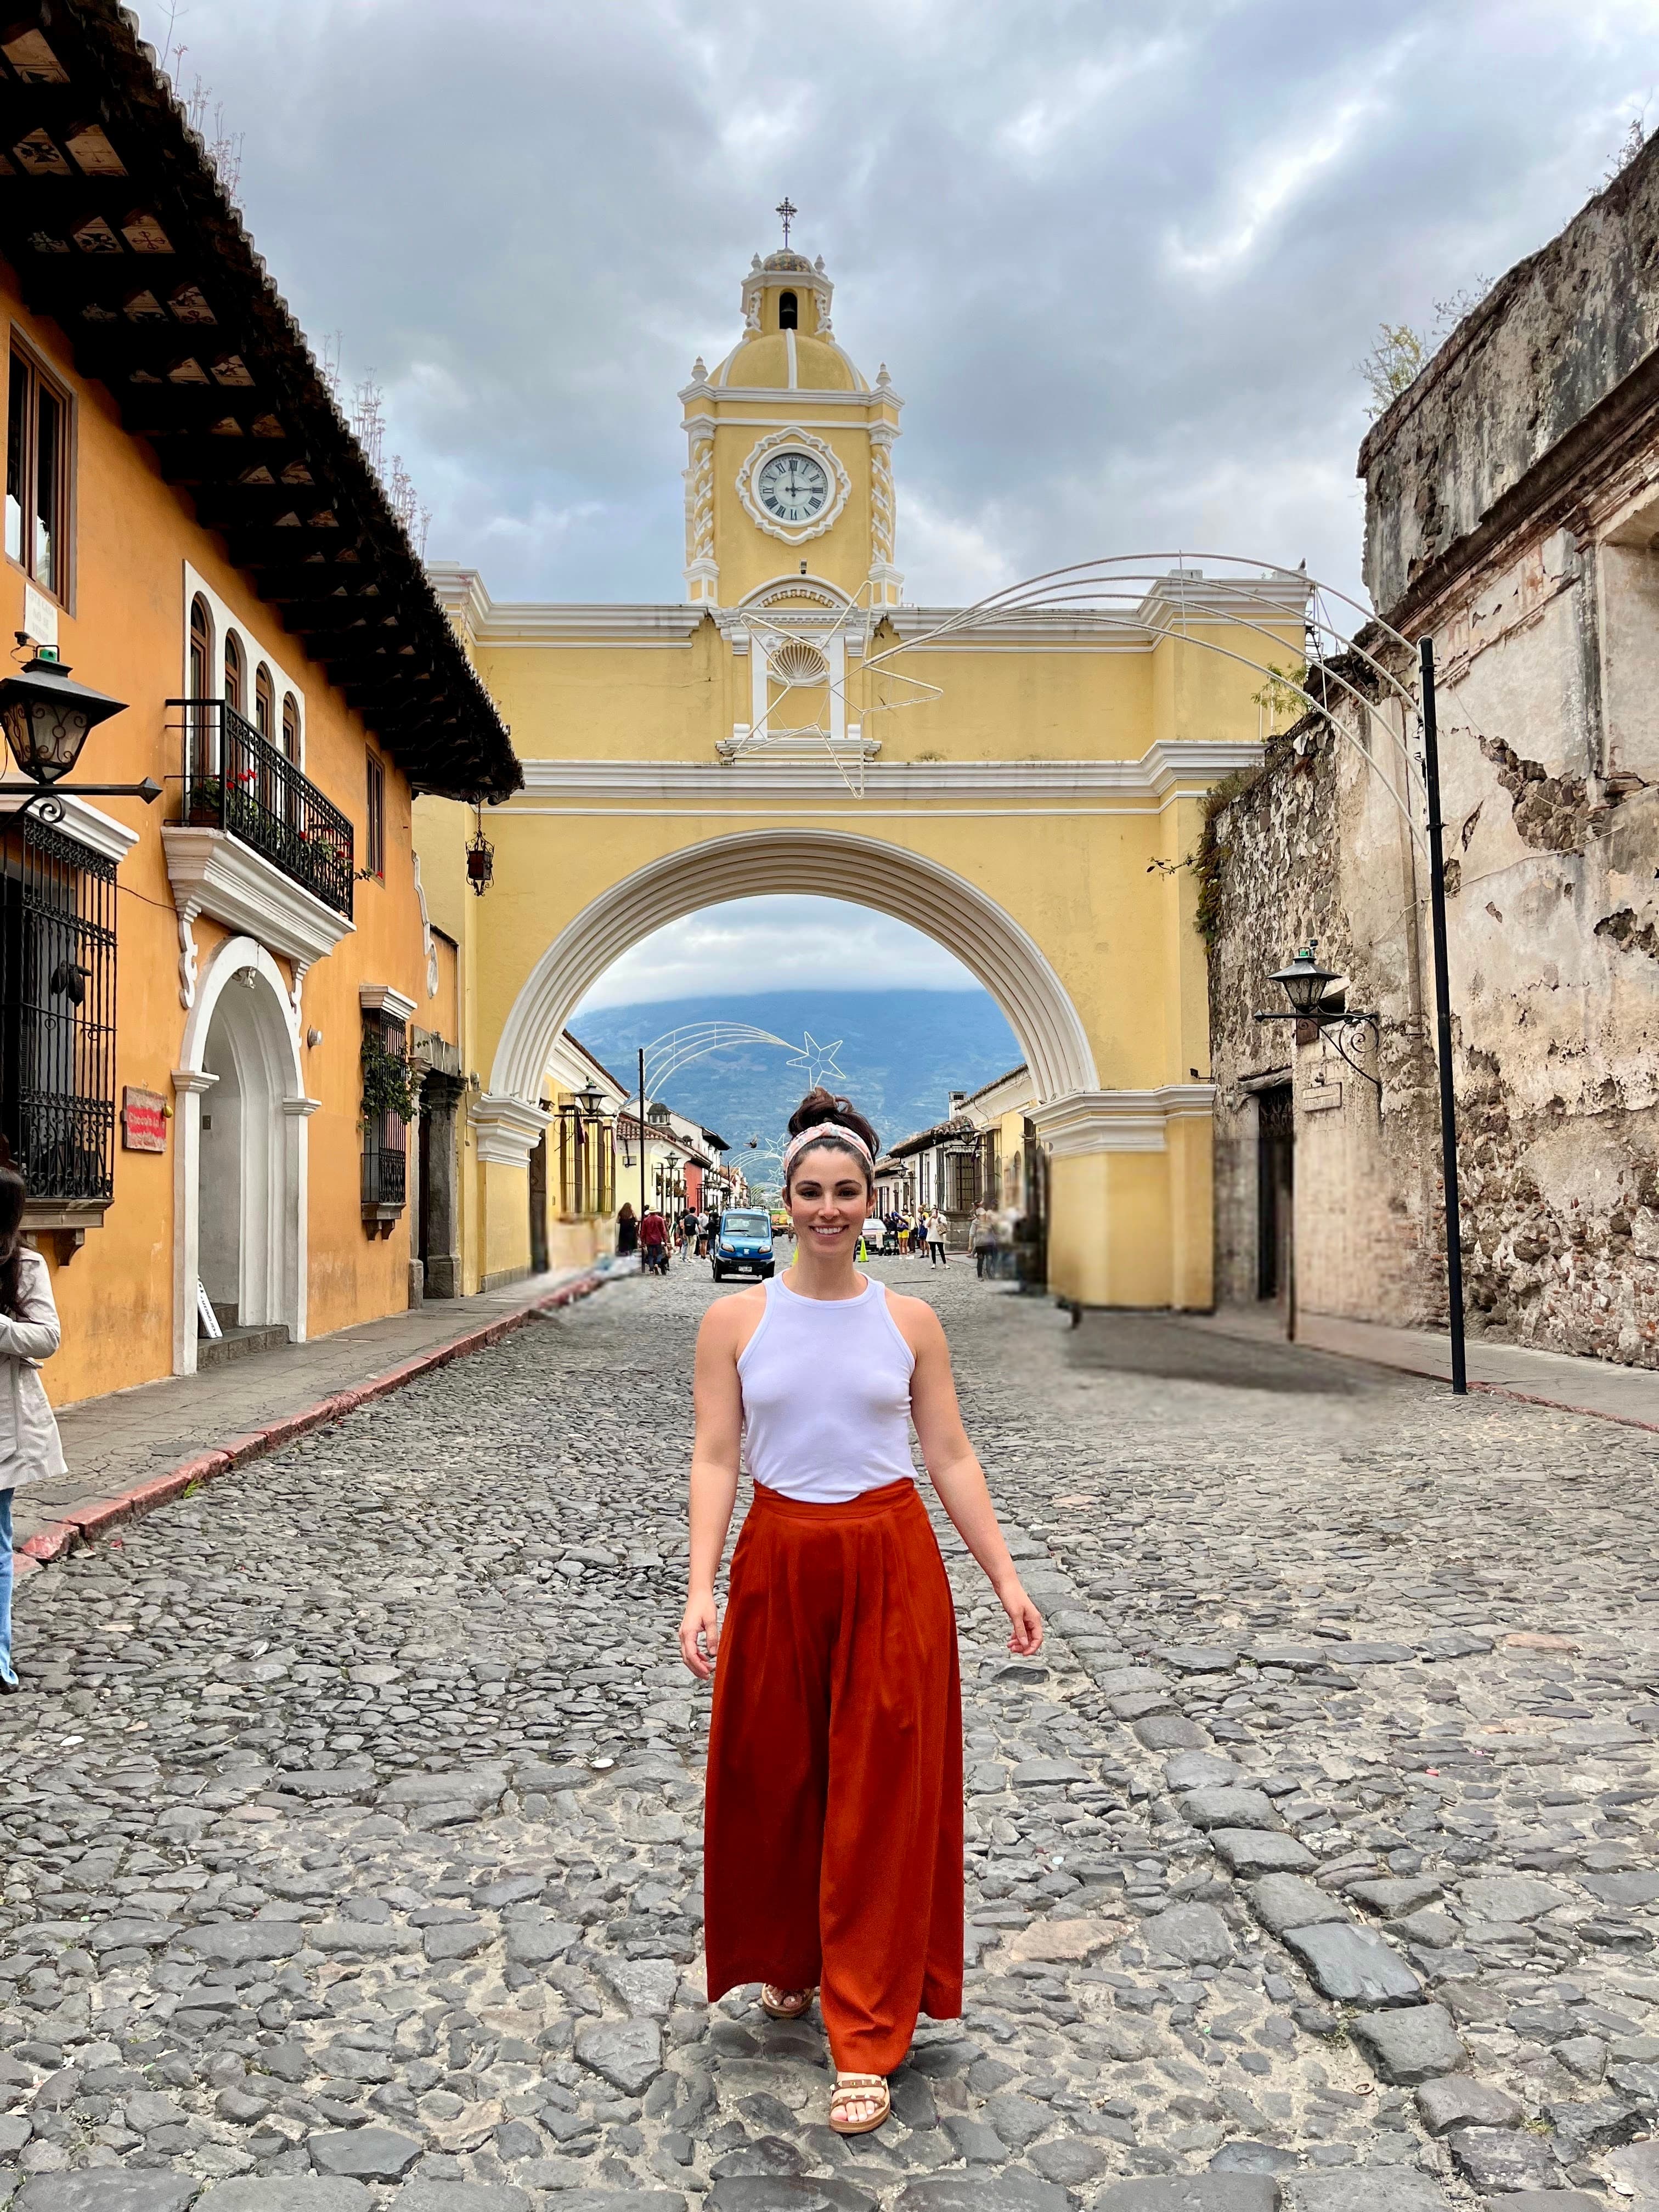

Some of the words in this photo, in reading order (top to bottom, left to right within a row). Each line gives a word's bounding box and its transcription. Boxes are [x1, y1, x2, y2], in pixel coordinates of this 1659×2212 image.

[775, 463, 786, 475] XI
[802, 464, 809, 475] I
[765, 473, 777, 482] X
[809, 474, 820, 482] II
[791, 509, 797, 520] VI
[803, 506, 810, 517] V
